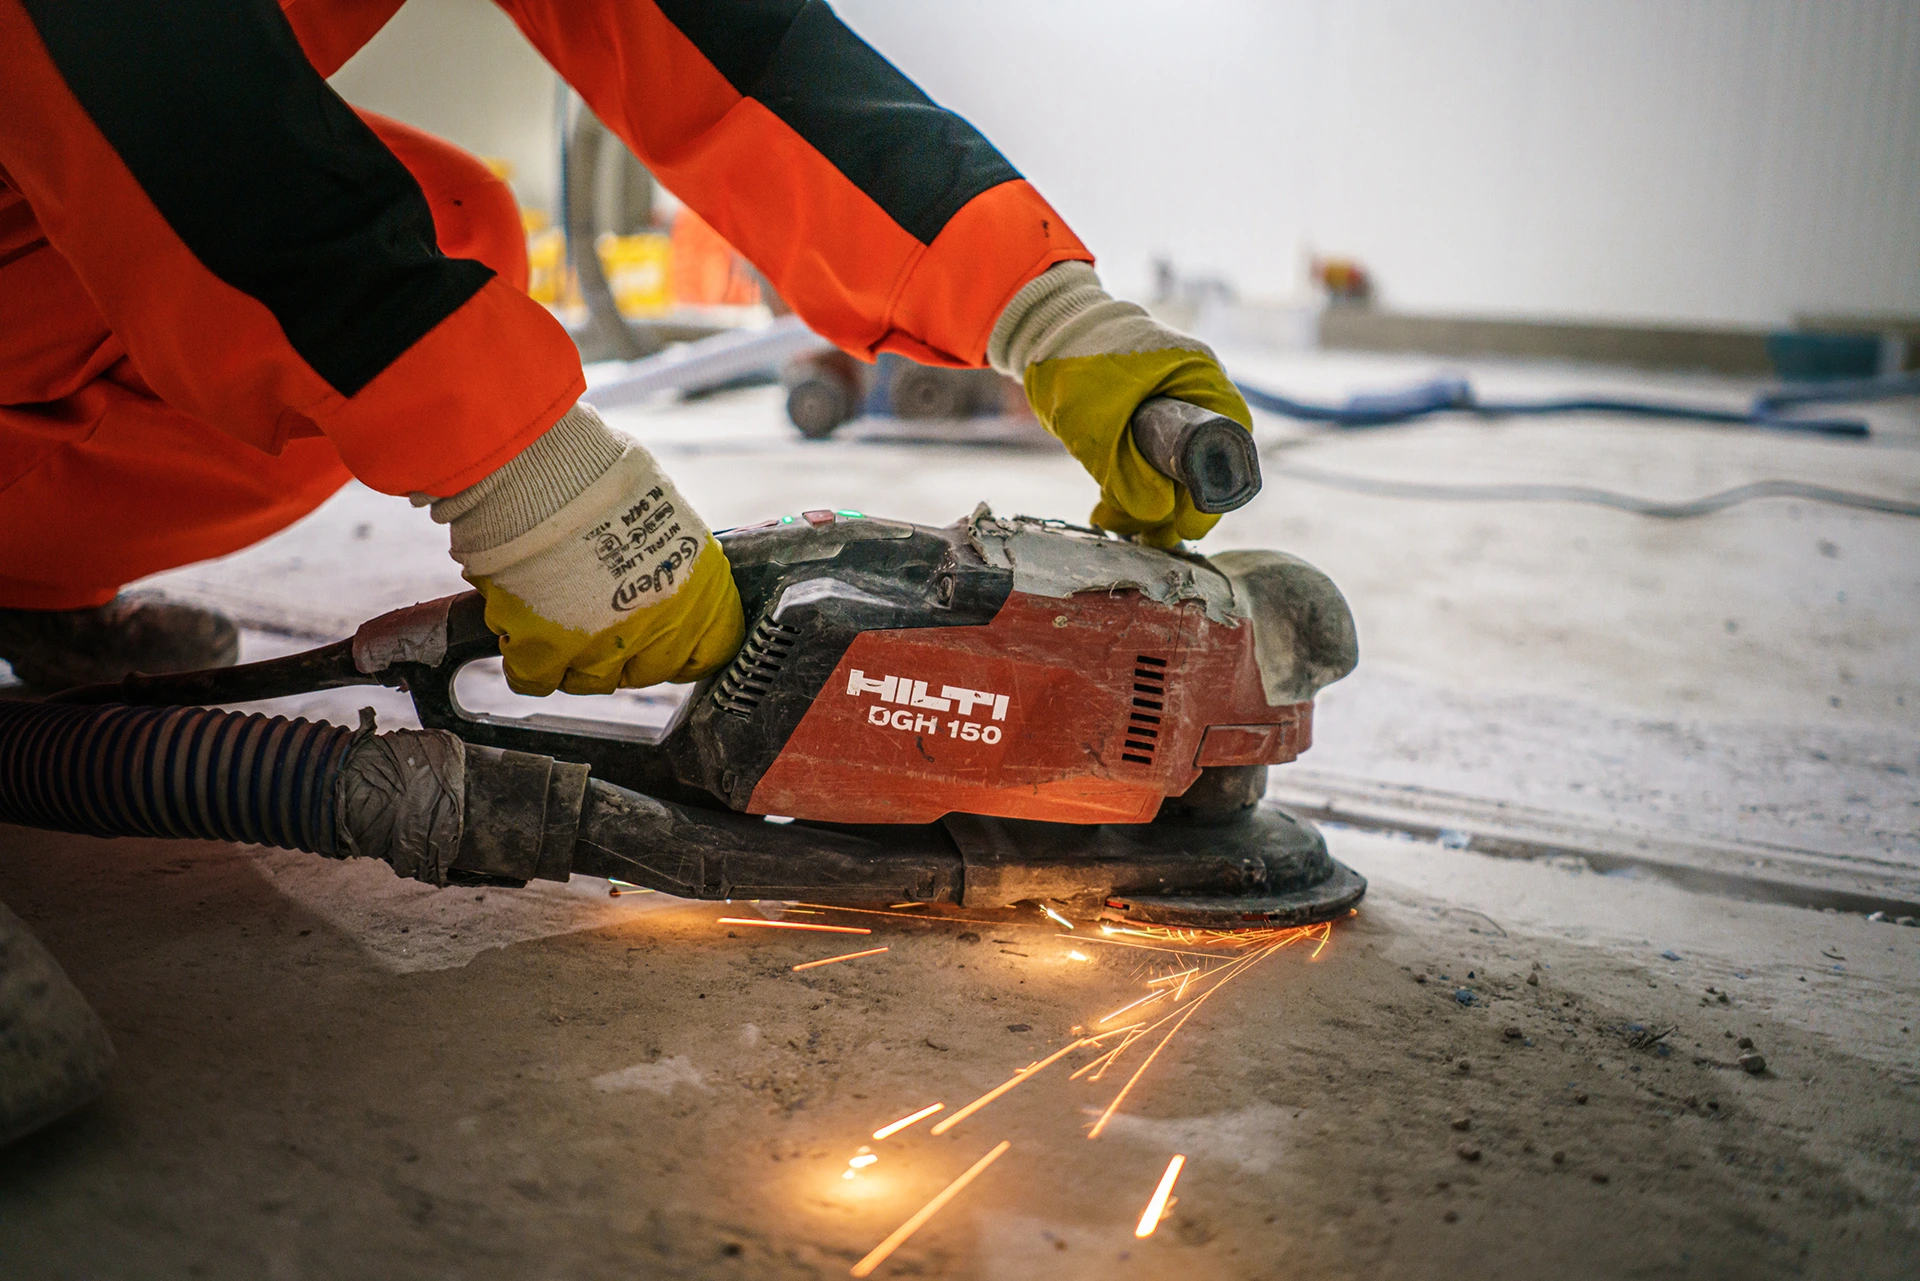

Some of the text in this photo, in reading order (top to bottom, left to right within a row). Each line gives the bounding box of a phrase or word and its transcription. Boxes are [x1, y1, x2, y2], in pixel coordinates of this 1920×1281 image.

[646, 486, 664, 501] NL
[643, 522, 681, 555] NITRIL
[610, 552, 645, 580] LINE
[846, 668, 1010, 721] HILTI
[867, 705, 1002, 745] DGH 150
